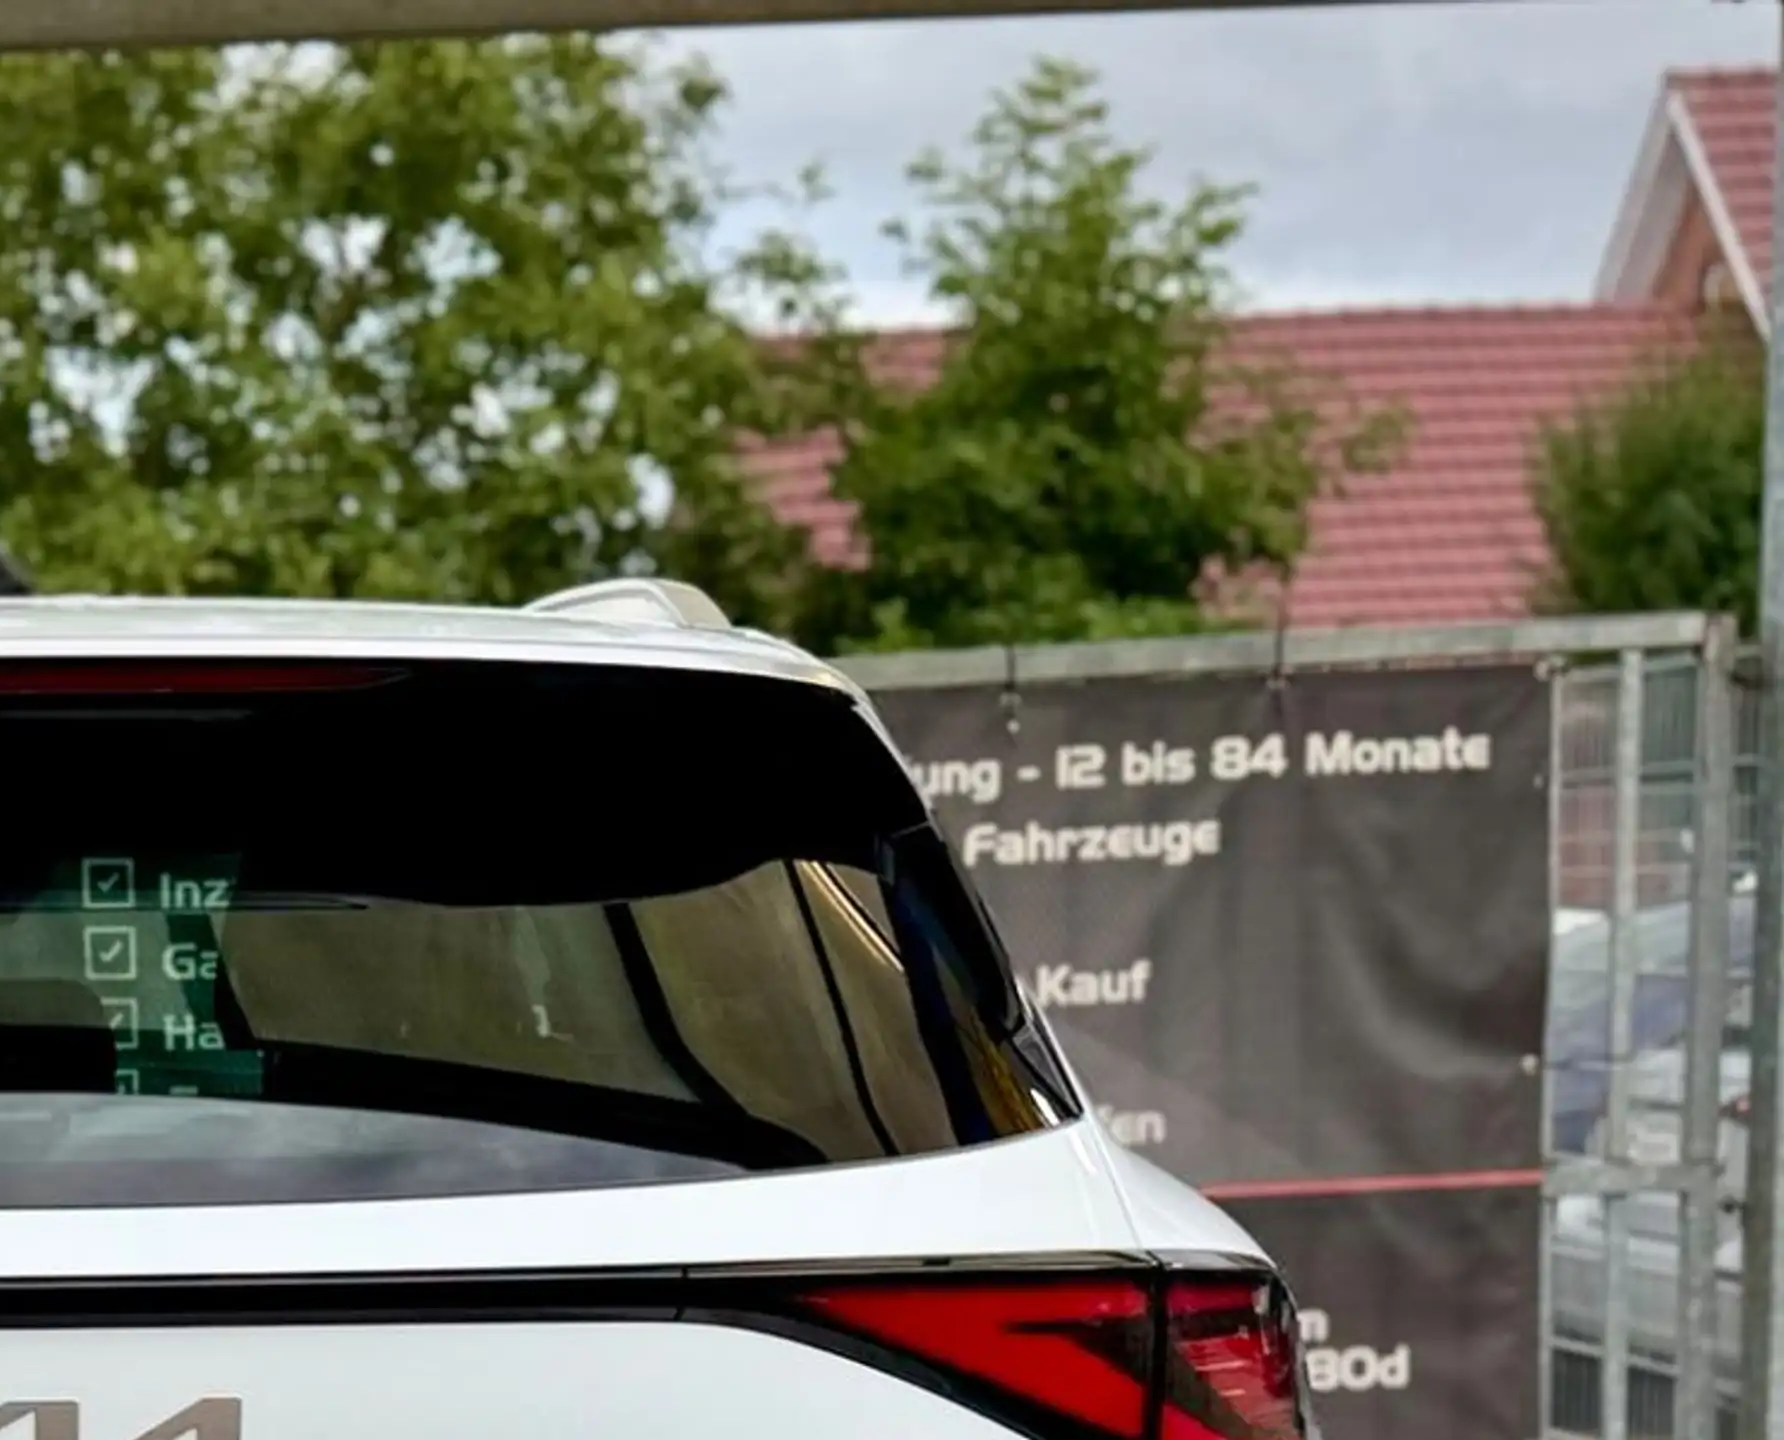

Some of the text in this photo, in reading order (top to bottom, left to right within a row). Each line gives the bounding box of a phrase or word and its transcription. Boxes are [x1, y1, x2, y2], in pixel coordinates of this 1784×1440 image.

[908, 758, 1001, 804] ung
[1121, 741, 1196, 786] bis
[1210, 733, 1289, 780] 84
[1304, 725, 1491, 777] Monate
[963, 820, 1221, 867] Fahrzeuge
[1035, 958, 1152, 1007] Kauf
